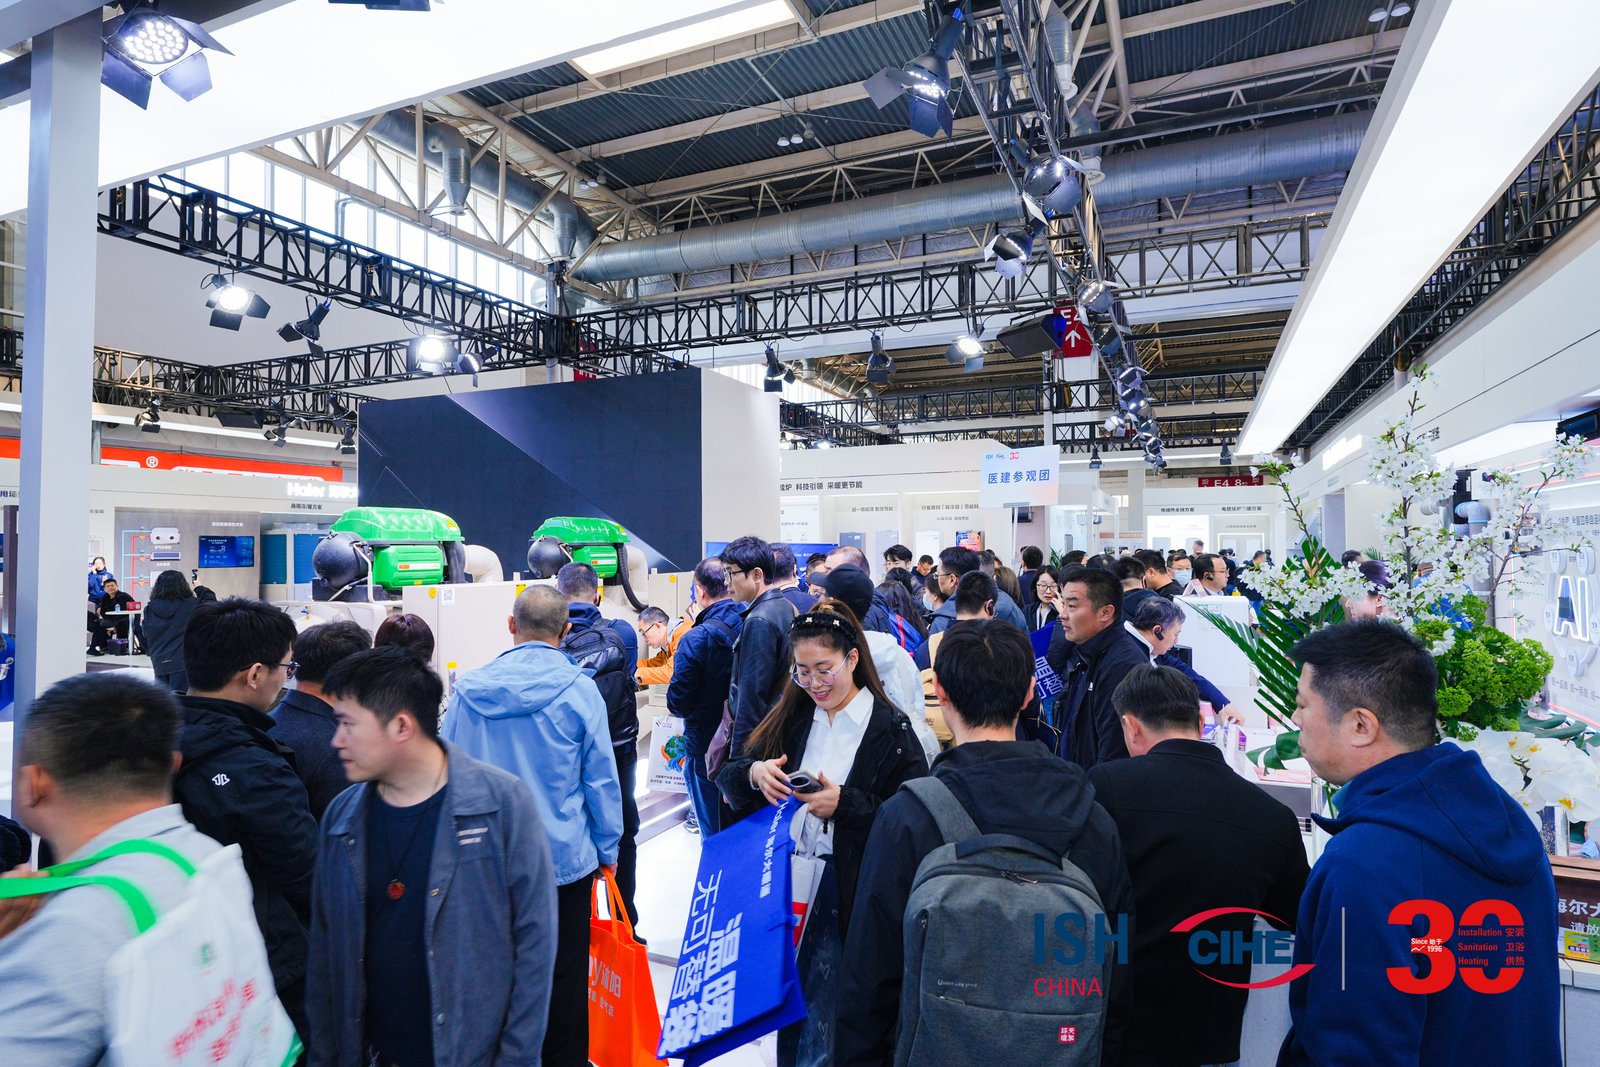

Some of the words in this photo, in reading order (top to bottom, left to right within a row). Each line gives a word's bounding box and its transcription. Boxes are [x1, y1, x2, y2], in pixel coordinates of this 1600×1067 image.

[987, 469, 1050, 485] 医建参观团
[1553, 575, 1590, 642] AI
[767, 801, 790, 837] Haier
